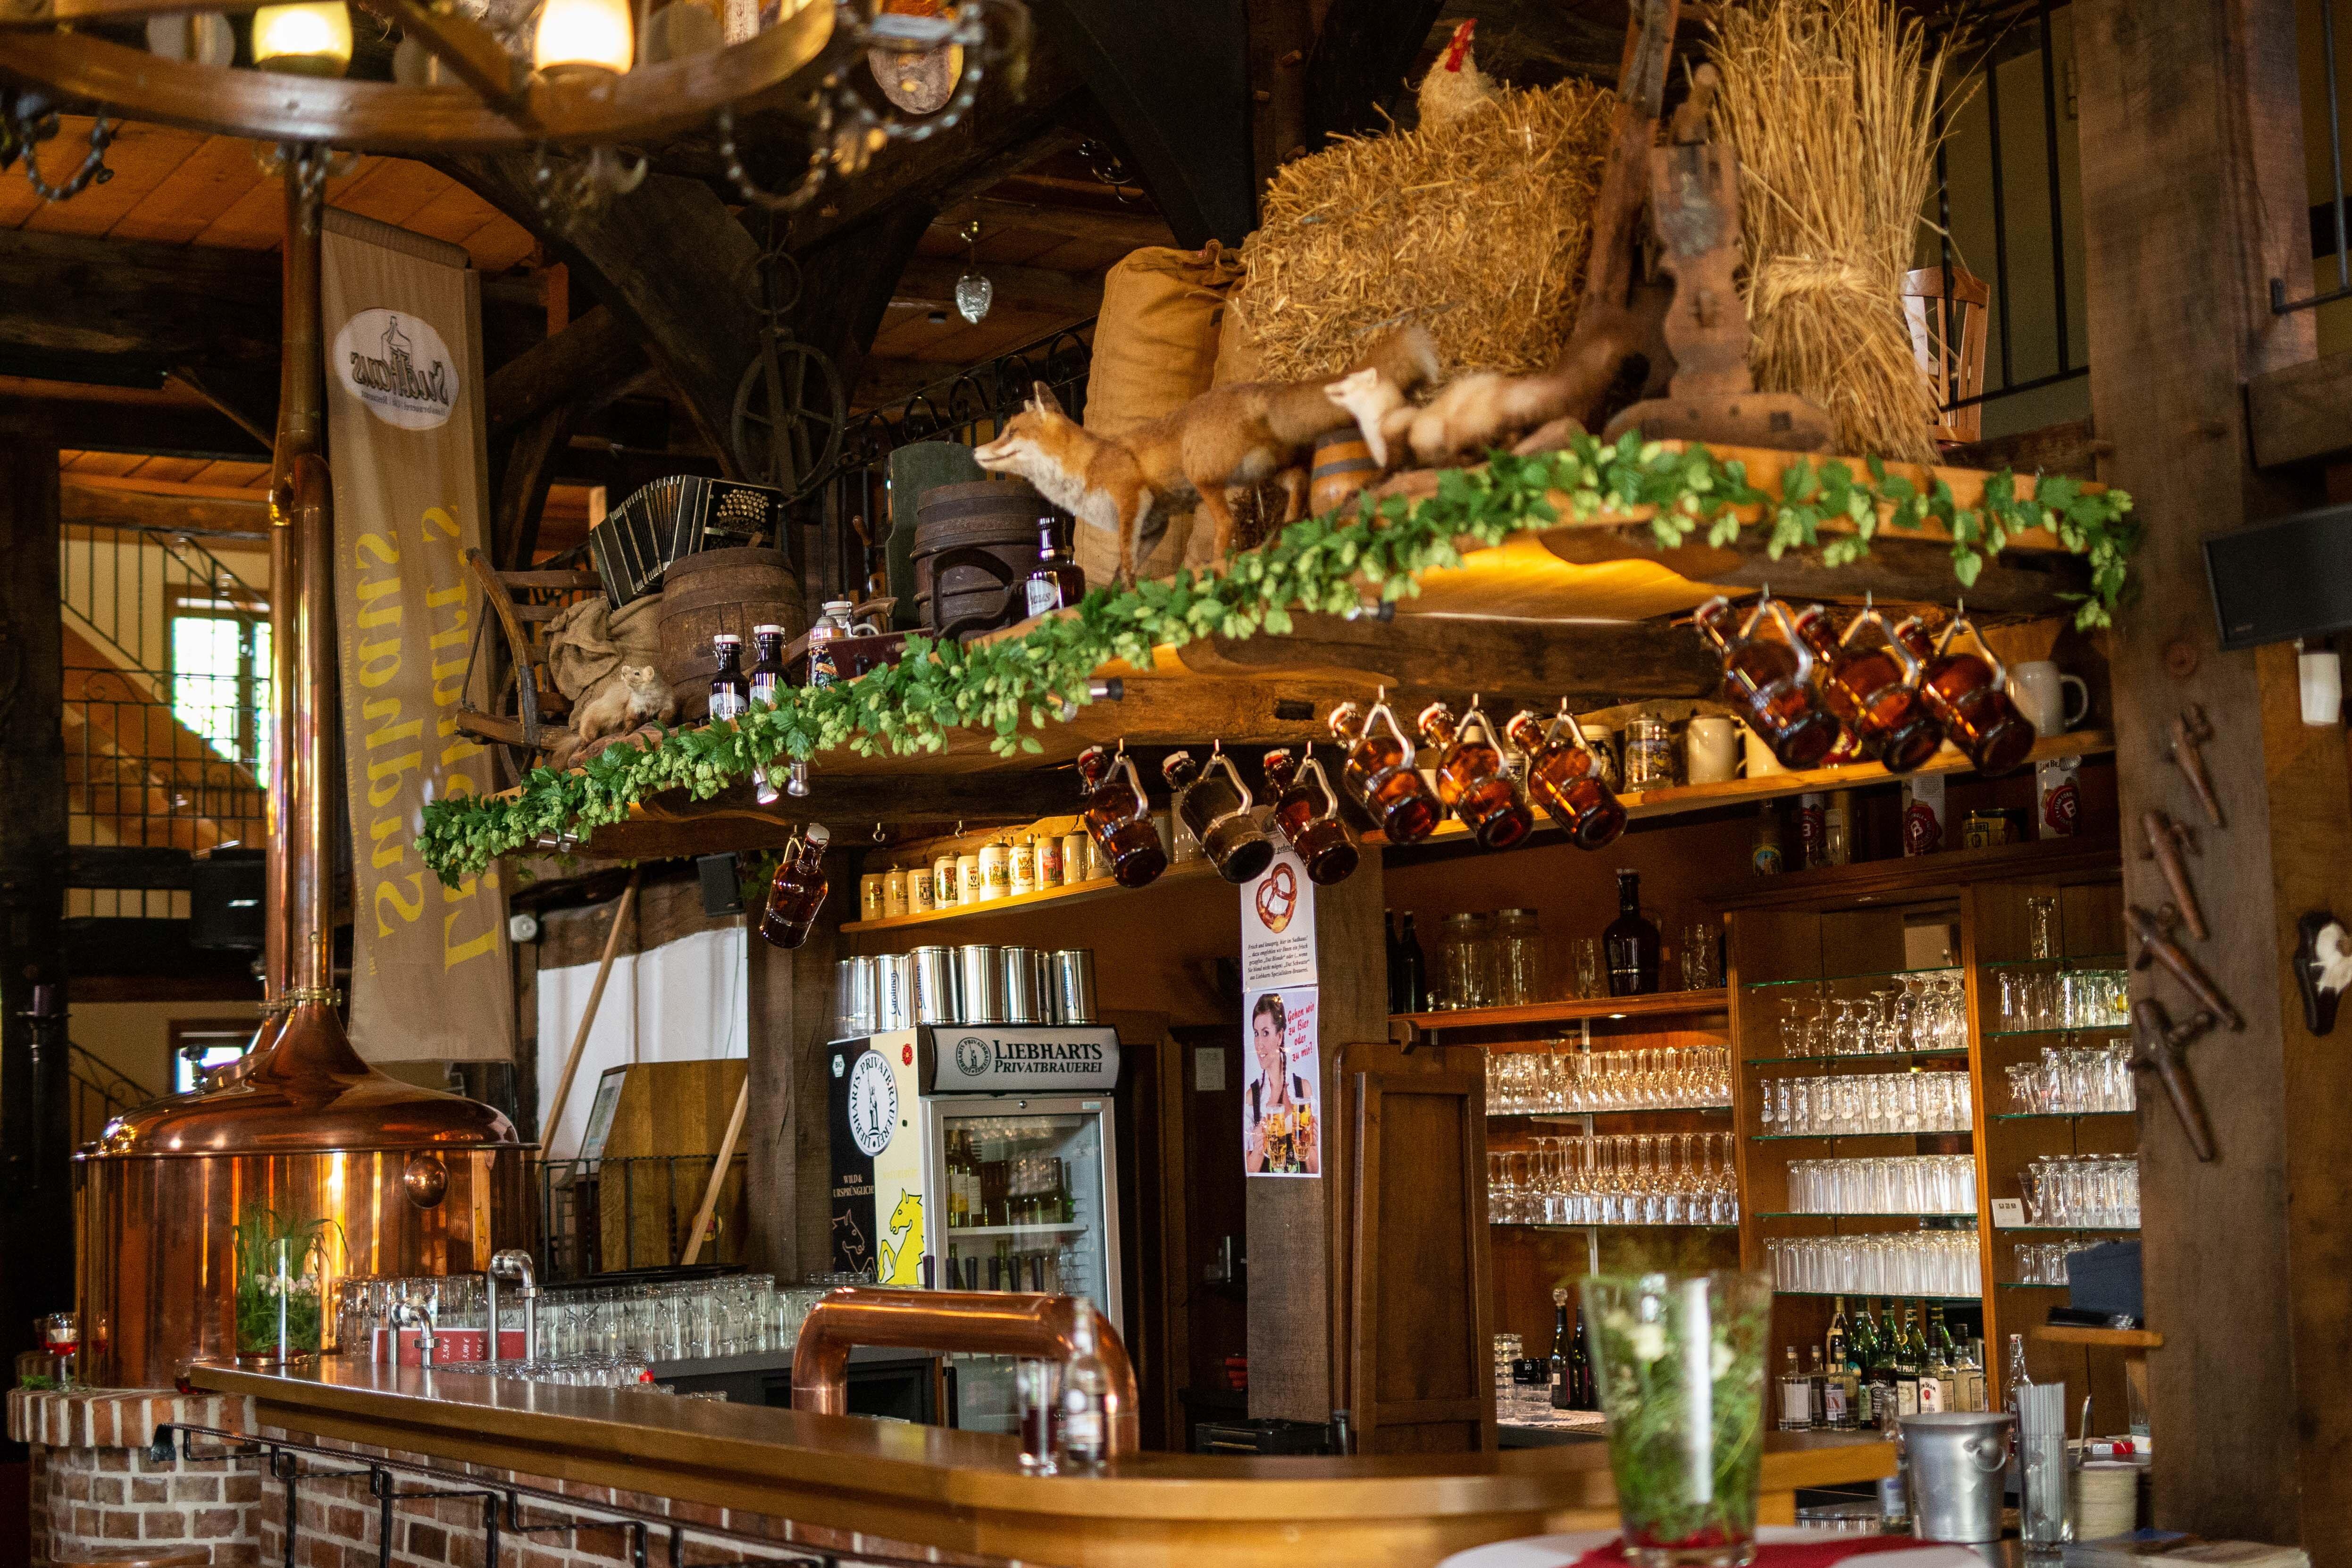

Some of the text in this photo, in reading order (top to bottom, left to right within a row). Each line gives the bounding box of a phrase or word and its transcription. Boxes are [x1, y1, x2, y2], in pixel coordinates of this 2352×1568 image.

[1298, 943, 1308, 951] frisch
[1288, 1002, 1314, 1024] Gehen wir
[1288, 1019, 1309, 1036] zu Bier
[1294, 1033, 1306, 1046] oder
[993, 1040, 1103, 1059] LIEBHARTS
[1292, 1041, 1313, 1062] zu mir?
[994, 1060, 1103, 1073] PRIVATBRAUEREI
[852, 1057, 896, 1148] LIEBHARTS PRIVATBRAUEREI
[1925, 1382, 1936, 1392] BEAM
